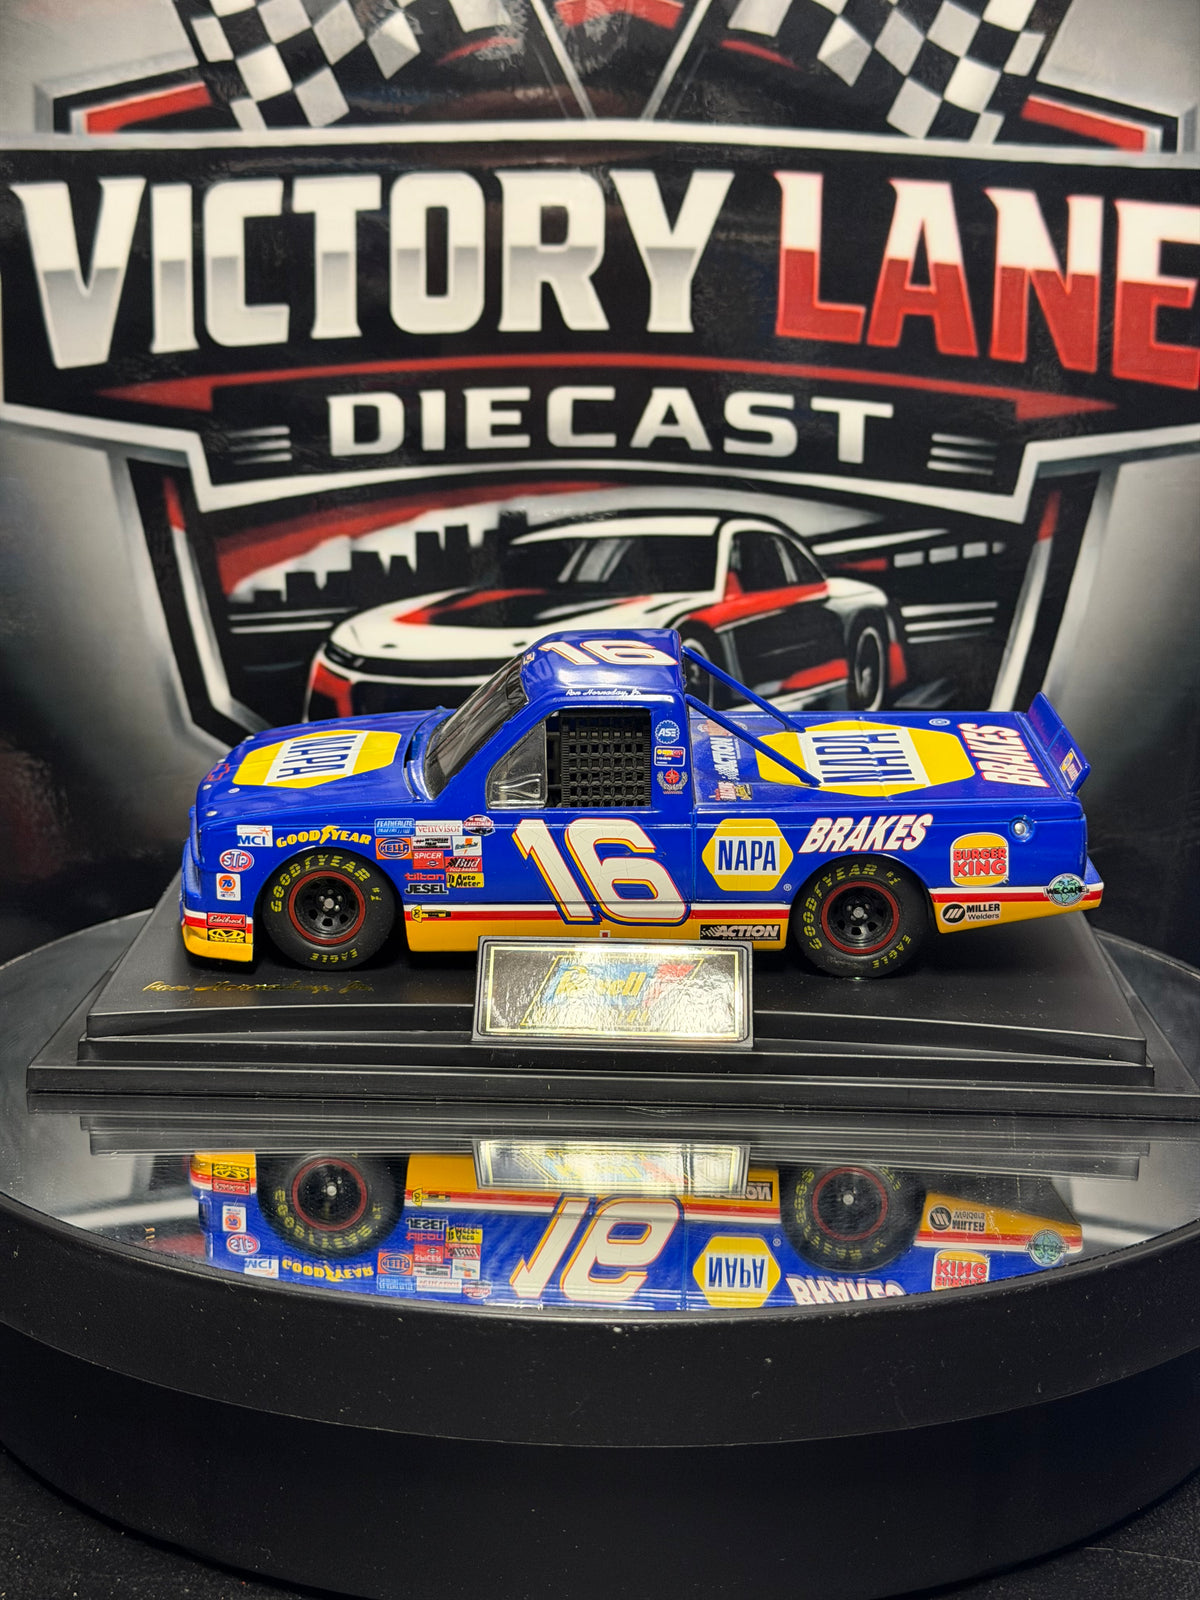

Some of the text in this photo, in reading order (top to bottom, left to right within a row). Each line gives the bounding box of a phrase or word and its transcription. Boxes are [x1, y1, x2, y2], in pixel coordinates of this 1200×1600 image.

[11, 168, 1200, 390] VICTORY LANE
[328, 386, 894, 464] DIECAST
[538, 640, 679, 666] 16
[658, 728, 677, 737] ASE
[276, 734, 358, 779] NAPA
[812, 731, 916, 783] NAPA
[957, 722, 1050, 788] BRAKES
[238, 835, 266, 846] MCI
[276, 825, 372, 848] GOODYEAR
[798, 814, 934, 854] BRAKES
[222, 850, 249, 868] STP
[455, 858, 481, 868] Bud
[717, 839, 777, 872] NAPA
[952, 847, 1008, 862] BURGER
[404, 872, 445, 881] tilton
[456, 873, 476, 881] Auto
[512, 818, 690, 925] 16
[953, 859, 1007, 877] KING
[221, 879, 233, 888] 76
[405, 883, 448, 894] JESEL
[966, 903, 1001, 914] MILLER
[967, 911, 1000, 921] Welders
[714, 925, 779, 937] ACTION
